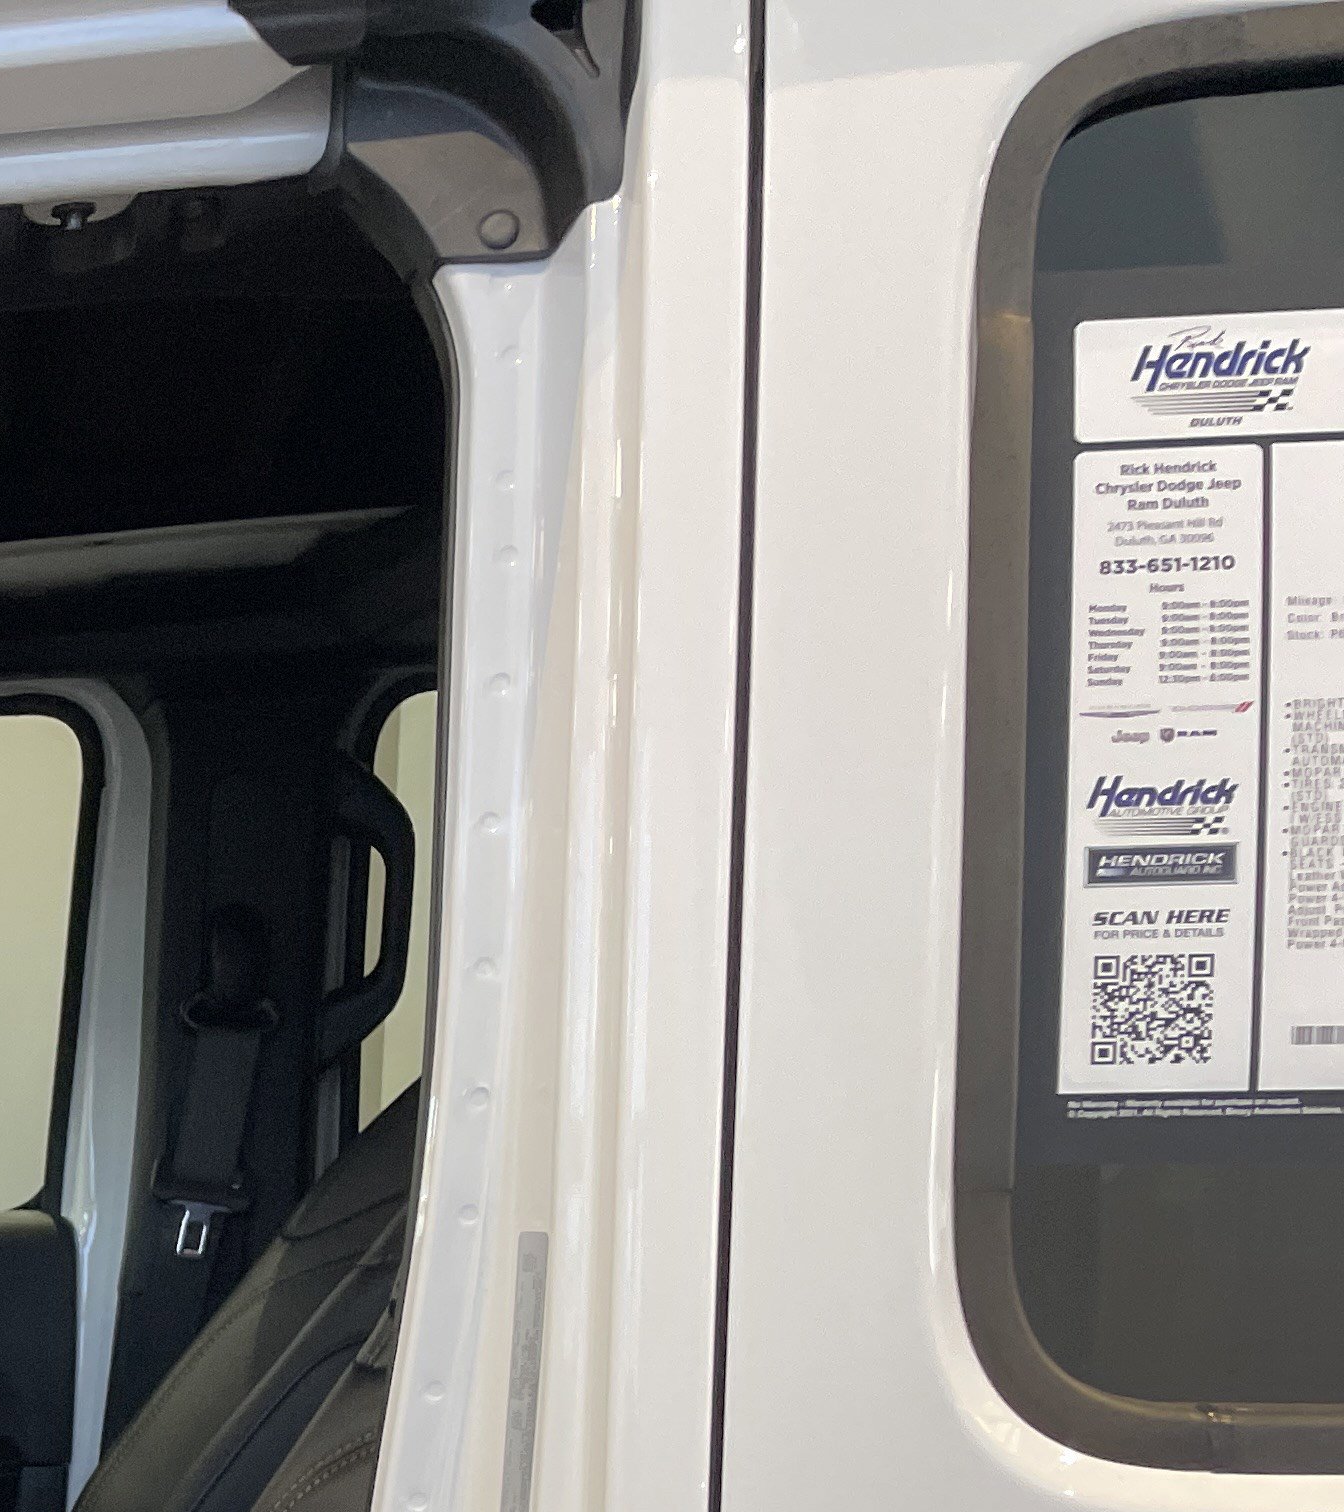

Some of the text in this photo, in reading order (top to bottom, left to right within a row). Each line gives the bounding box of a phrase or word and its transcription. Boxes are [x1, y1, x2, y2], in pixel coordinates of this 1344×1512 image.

[1130, 338, 1311, 392] Hendrick
[1190, 416, 1244, 428] DULUTH
[1120, 460, 1217, 476] Rick Hendrick
[1095, 478, 1242, 496] Chrysler Dodge Jeep
[1127, 496, 1210, 511] Ram Duluth
[1099, 554, 1237, 576] 833-651-1210
[1149, 582, 1185, 594] Hours
[1086, 775, 1239, 818] Hendrick
[1108, 806, 1185, 818] AUTOMOTIVE
[1099, 851, 1227, 867] HENDRICK
[1092, 908, 1231, 926] SCAN HERE
[1093, 930, 1120, 940] FOR
[1123, 928, 1159, 939] PRICE
[1174, 927, 1225, 938] DETAILS
